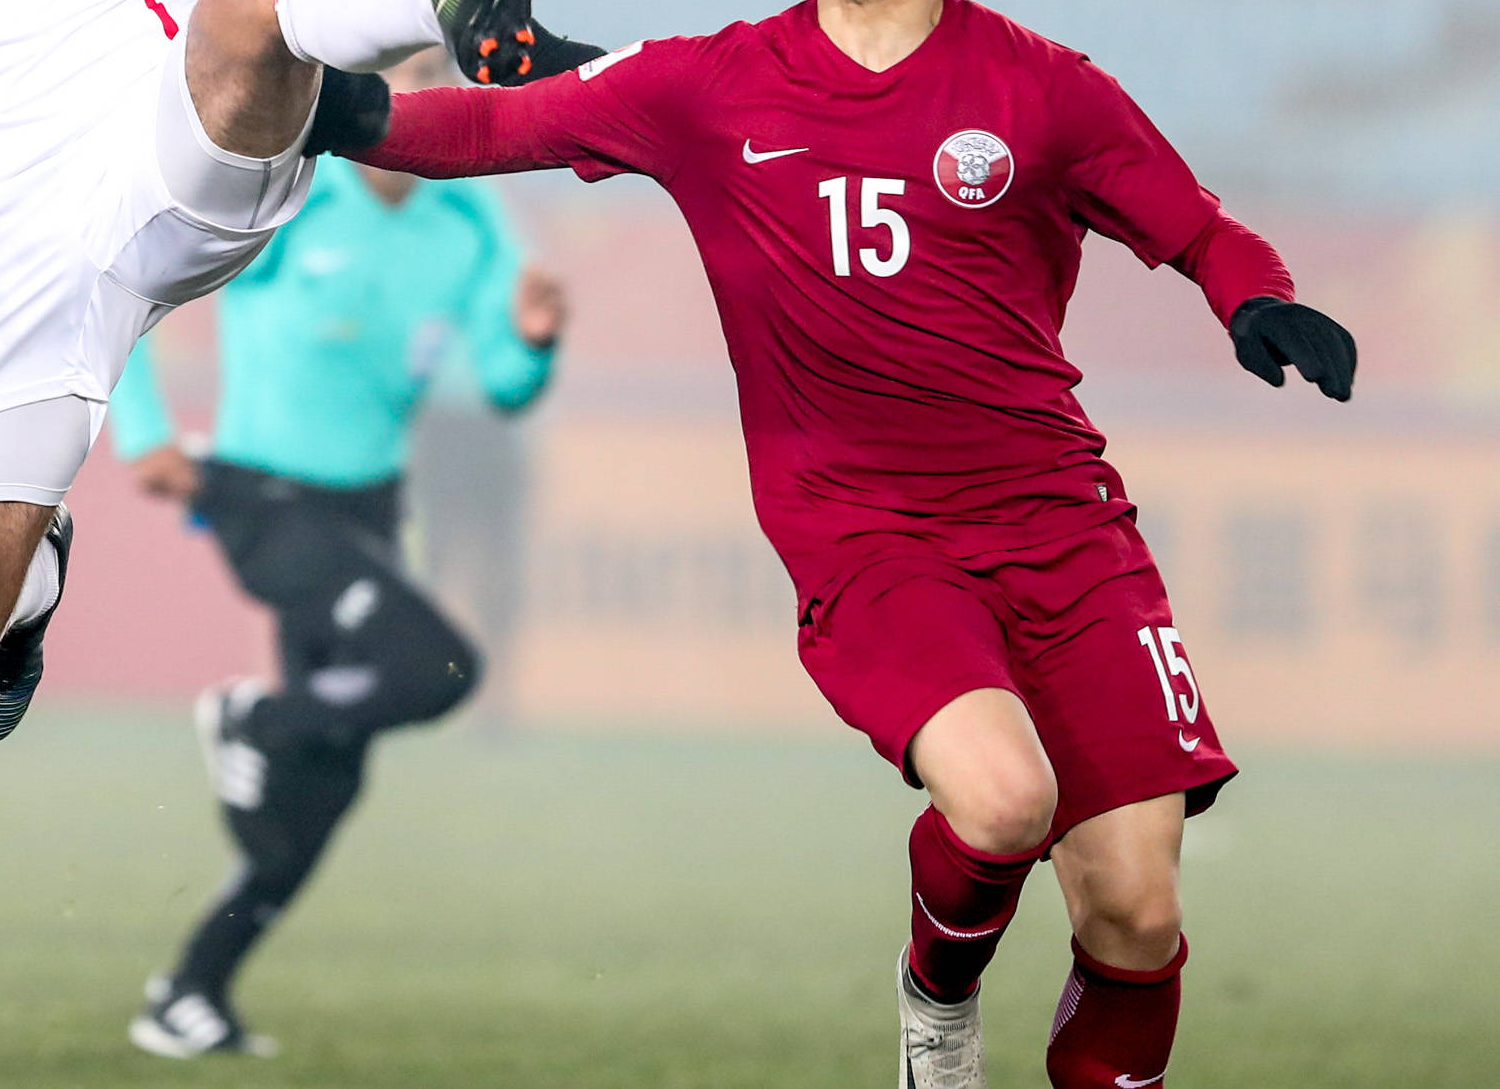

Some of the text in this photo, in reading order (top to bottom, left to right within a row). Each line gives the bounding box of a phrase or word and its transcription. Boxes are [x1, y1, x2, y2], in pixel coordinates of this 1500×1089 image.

[818, 176, 910, 277] 15
[958, 186, 986, 200] QFA
[1137, 625, 1200, 724] 15
